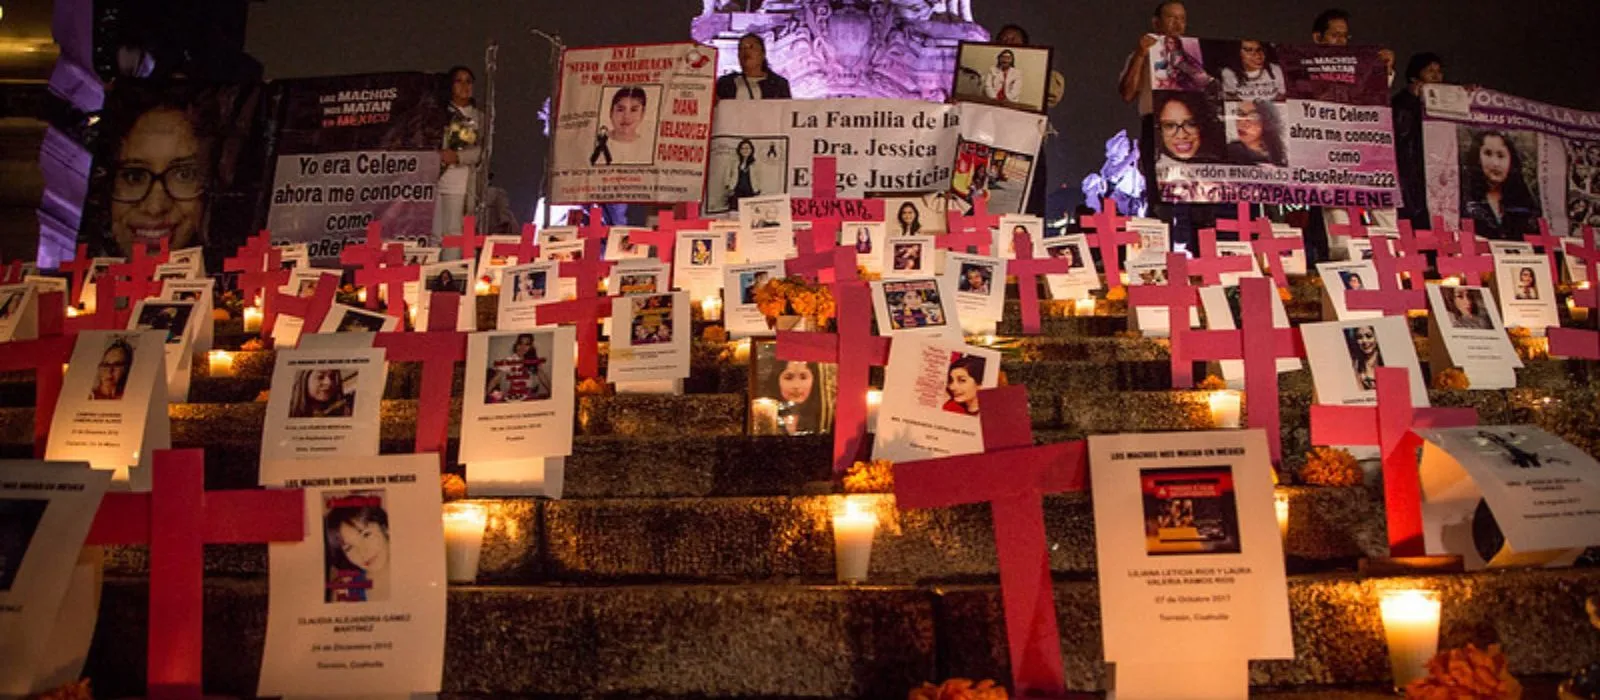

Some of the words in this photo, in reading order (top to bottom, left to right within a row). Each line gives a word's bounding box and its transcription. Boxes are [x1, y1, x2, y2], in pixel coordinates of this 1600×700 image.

[337, 87, 397, 102] MACHOS
[342, 101, 391, 114] MATAN
[673, 98, 698, 115] DIANA
[1302, 102, 1316, 118] Yo
[1319, 106, 1337, 120] era
[1339, 107, 1378, 122] Celene
[1526, 102, 1550, 119] DE
[1553, 109, 1574, 125] LA
[791, 111, 818, 129] La
[826, 111, 904, 129] Familia
[912, 111, 937, 129] de
[943, 112, 960, 129] la
[1290, 123, 1322, 140] ahora
[1325, 129, 1342, 141] me
[1345, 130, 1392, 144] conocen
[657, 143, 704, 163] FLORENCIO
[812, 138, 859, 155] Dra.
[865, 139, 937, 157] Jessica
[300, 157, 318, 175] Yo
[323, 160, 350, 174] era
[357, 153, 417, 174] Celene
[1328, 151, 1360, 163] como
[793, 167, 857, 191] Ege
[864, 167, 949, 189] Justicia
[1293, 167, 1395, 187] #CasoReforma222
[274, 184, 322, 204] ahora
[328, 187, 354, 202] me
[360, 184, 433, 202] conocen
[327, 212, 373, 230] como
[1111, 452, 1124, 461] LOS
[1126, 451, 1157, 460] MACHOS
[1160, 450, 1175, 458] NOS
[285, 480, 299, 488] LOS
[301, 478, 331, 488] MACHOS
[333, 477, 348, 486] NOS
[1127, 569, 1160, 577] LILIANA
[1161, 568, 1193, 576] LETICIA
[1146, 578, 1182, 586] VALERIA
[1183, 577, 1214, 585] RAMOS
[298, 616, 333, 626] CLAUDIA
[335, 614, 382, 625] ALEJANDRA
